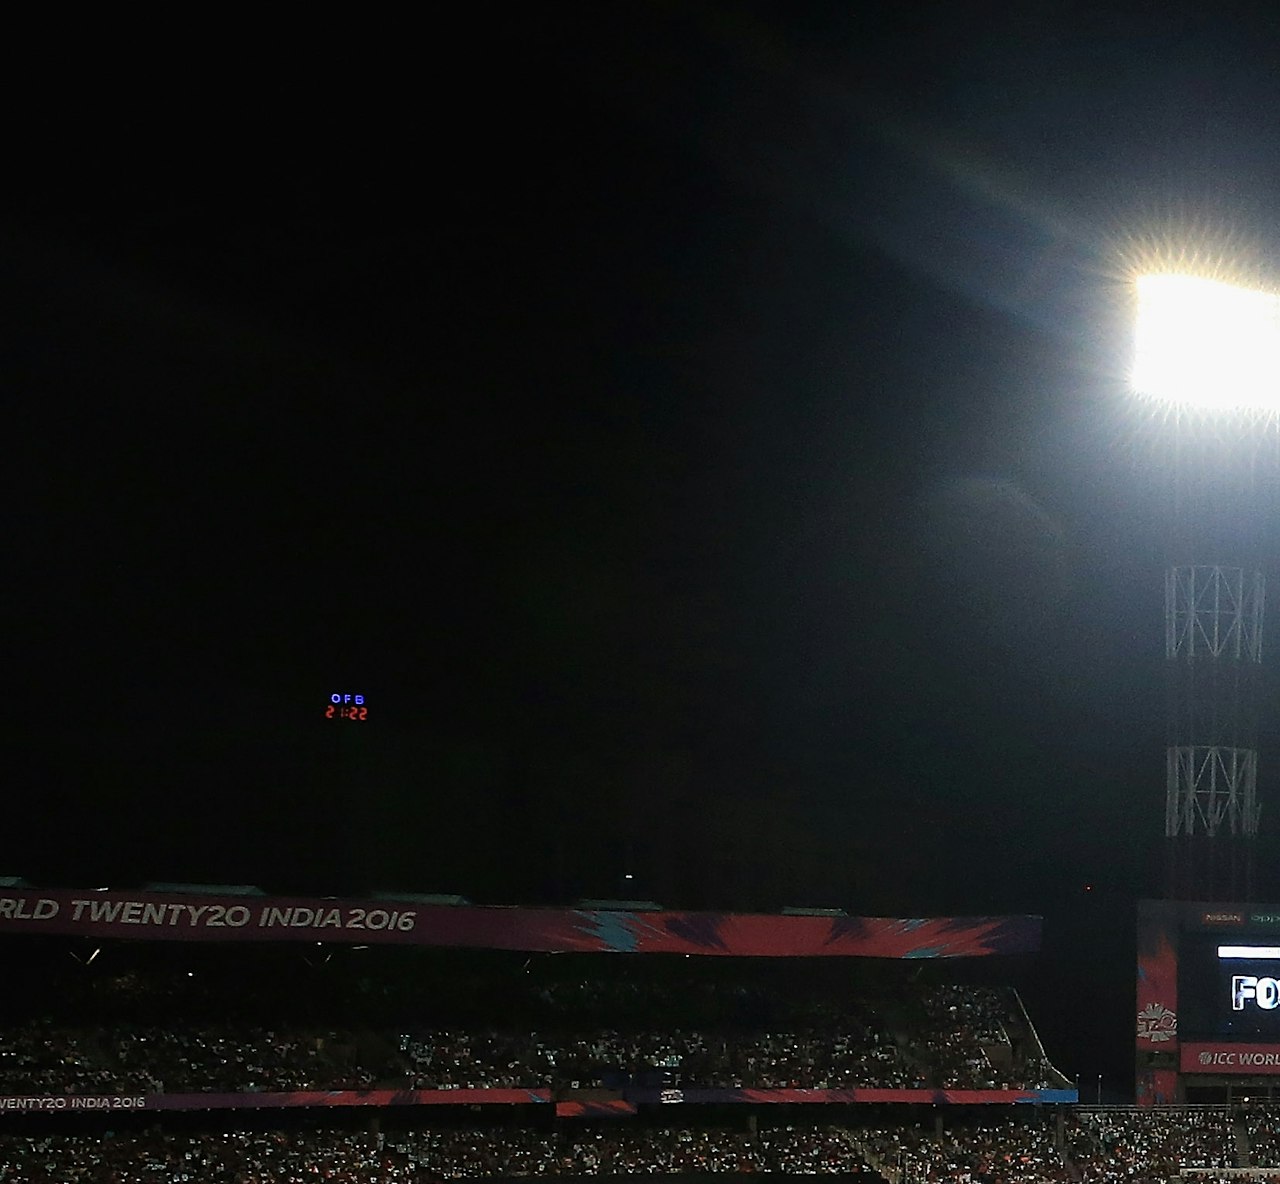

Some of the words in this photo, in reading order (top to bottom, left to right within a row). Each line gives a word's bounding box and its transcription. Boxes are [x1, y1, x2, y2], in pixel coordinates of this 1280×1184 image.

[70, 900, 250, 927] TWENTY20
[258, 906, 342, 928] INDIA
[345, 908, 417, 932] 2016
[1213, 1052, 1236, 1066] ICC
[71, 1097, 111, 1109] INDIA
[113, 1096, 146, 1109] 2016
